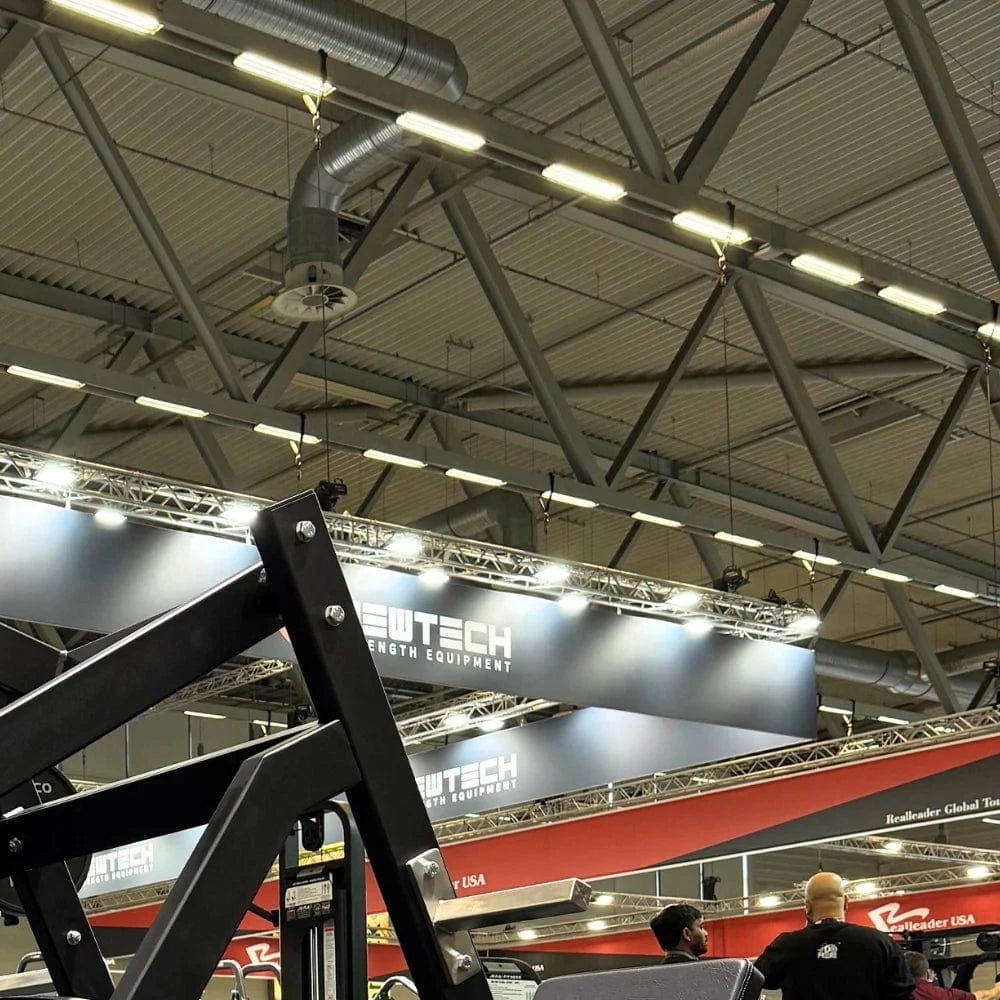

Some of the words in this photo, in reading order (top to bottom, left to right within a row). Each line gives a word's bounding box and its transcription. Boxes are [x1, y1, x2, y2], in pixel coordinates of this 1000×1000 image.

[353, 600, 512, 658] EWTECH
[368, 639, 417, 658] ENGTH
[426, 648, 512, 673] EQUIPMENT
[452, 779, 517, 803] EQUIPMENT
[886, 807, 941, 825] Realleader
[944, 799, 979, 815] Global
[462, 873, 486, 889] USA
[950, 914, 976, 927] USA
